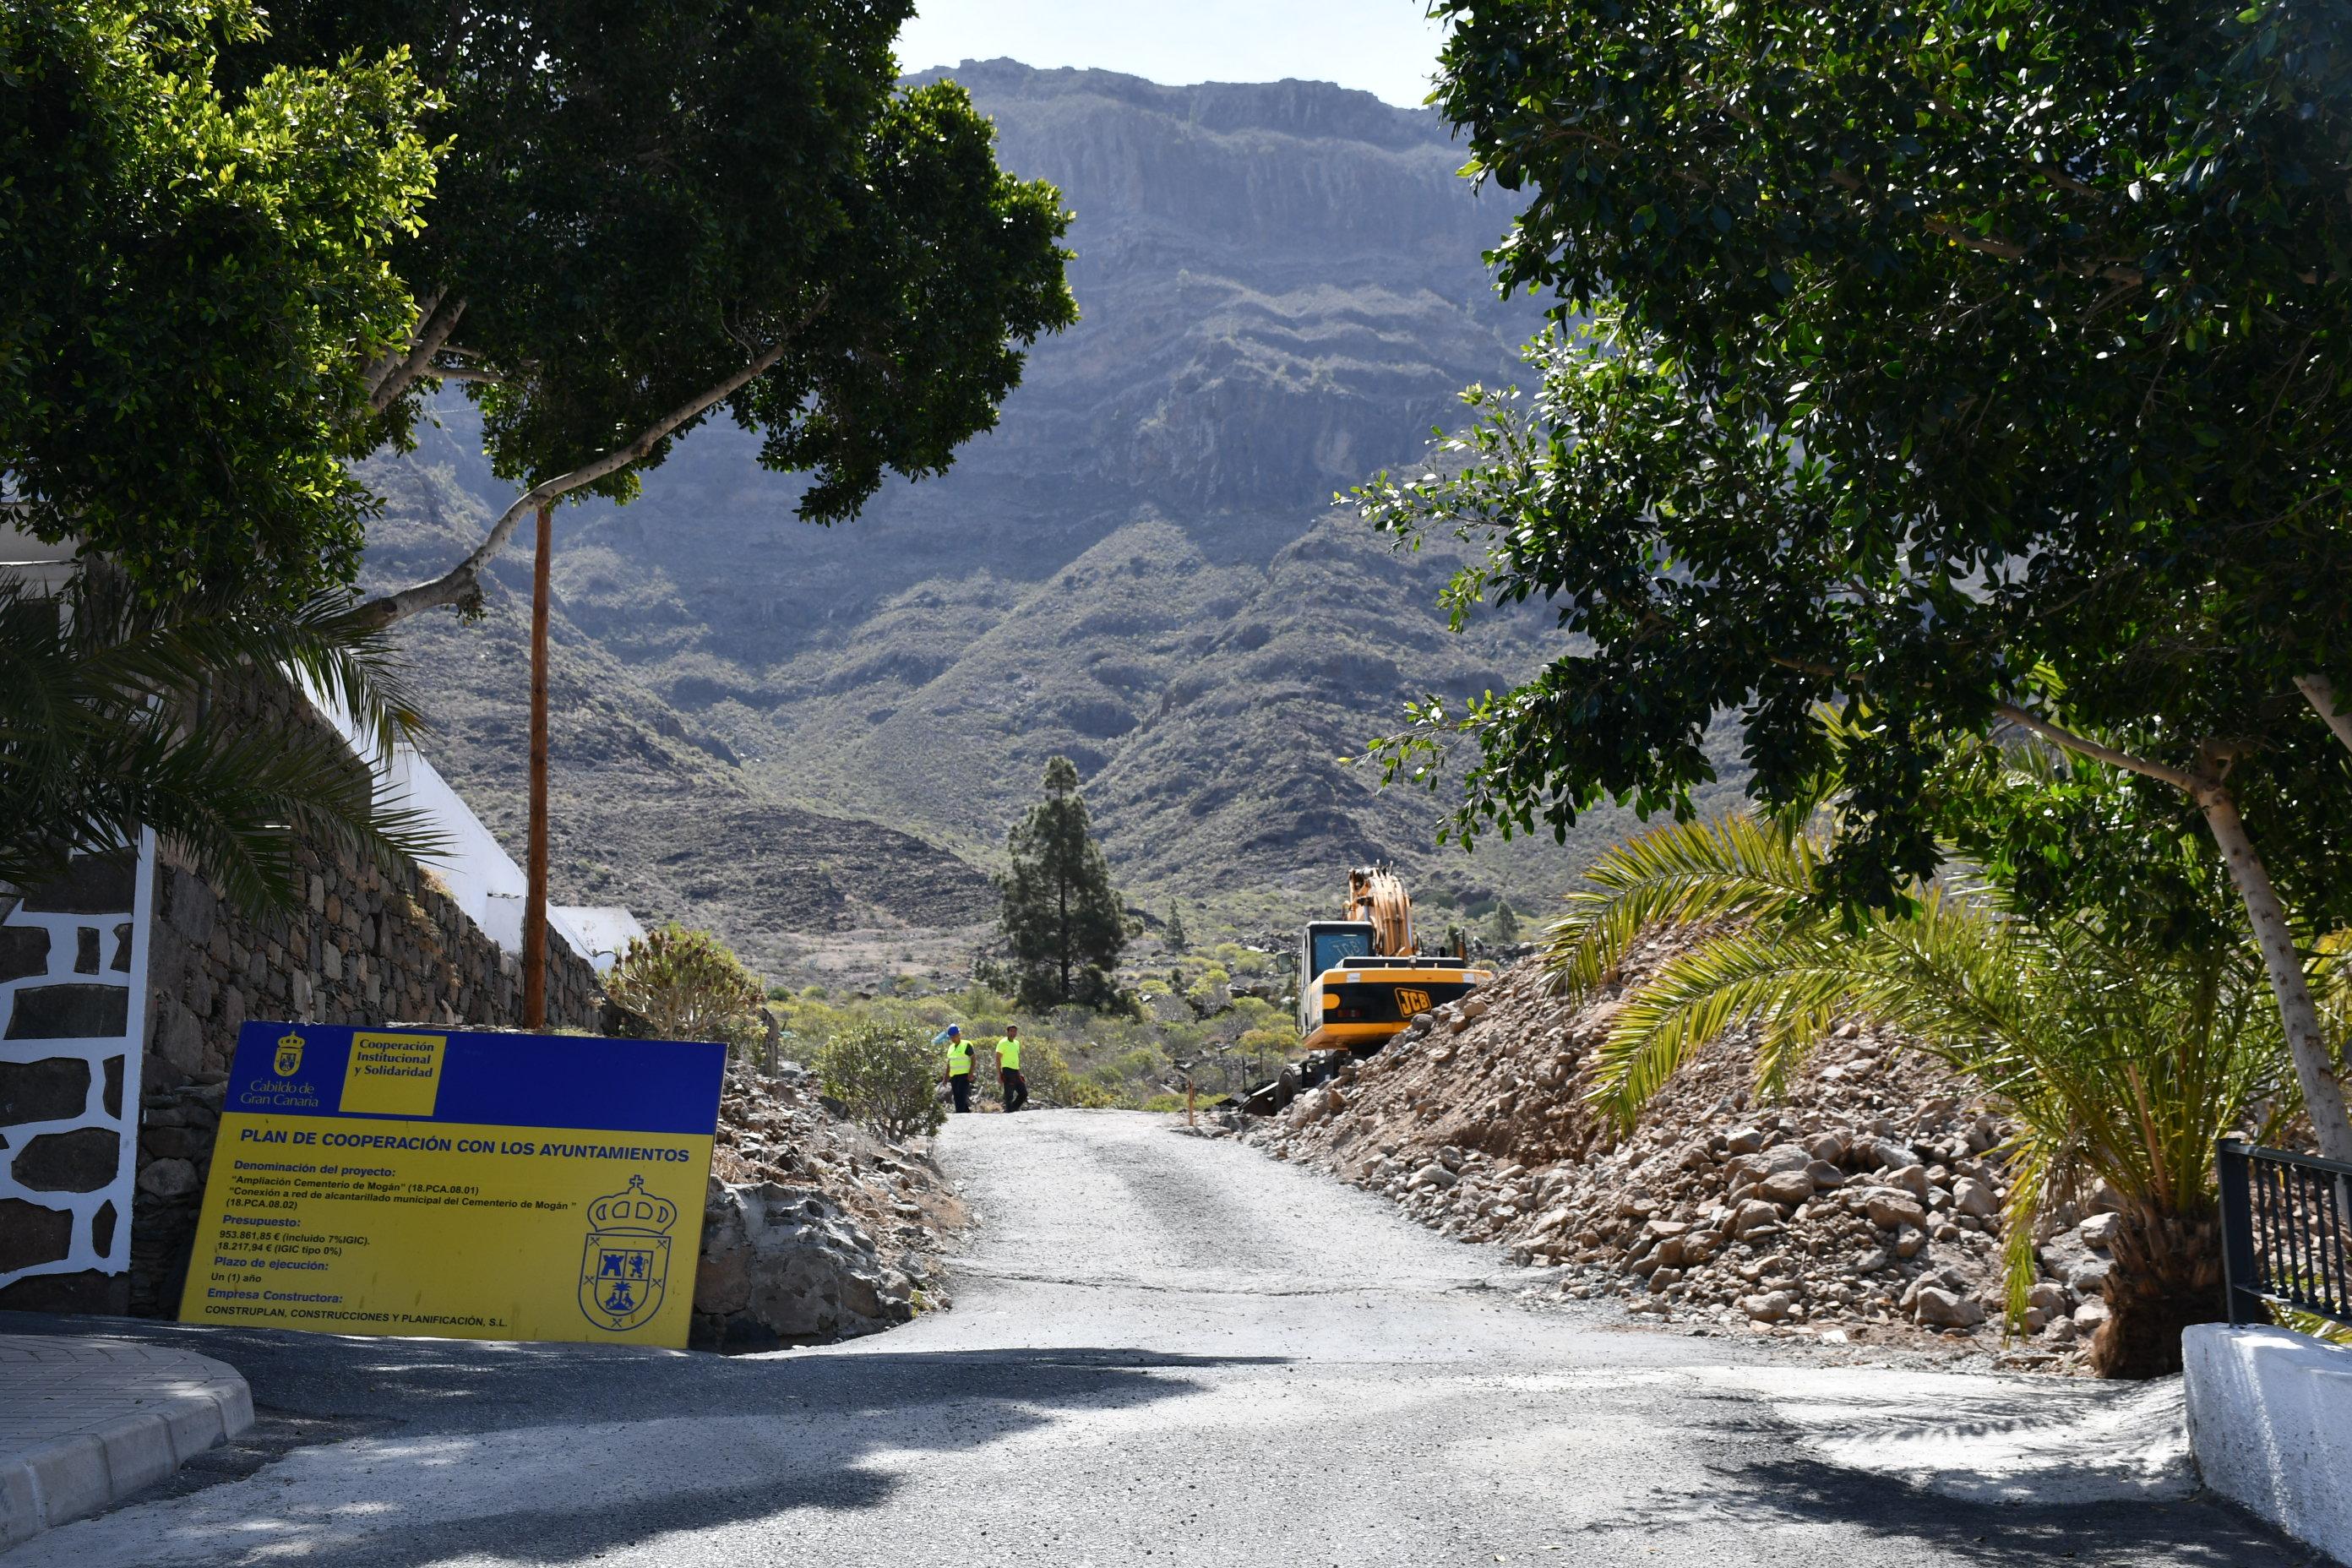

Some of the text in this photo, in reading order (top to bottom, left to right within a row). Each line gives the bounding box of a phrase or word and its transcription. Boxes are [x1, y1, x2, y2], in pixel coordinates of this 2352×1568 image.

[1401, 990, 1428, 1013] JCB
[360, 1039, 434, 1052] Cooperación
[357, 1052, 431, 1064] Institucional
[354, 1065, 433, 1077] y Solidaridad
[251, 1078, 314, 1093] Cabildo de
[241, 1092, 318, 1107] Gran Canaria
[241, 1129, 689, 1162] PLAN DE COOPERACIÓN CON LOS AYUNTAMIENTOS
[235, 1161, 395, 1178] Denominación del proyecto:
[294, 1179, 349, 1190] Cementerio
[408, 1184, 479, 1195] (18.PCA.08.01)
[226, 1199, 297, 1211] (18.PCA.08.02)
[310, 1191, 323, 1200] de
[324, 1192, 390, 1202] alcantarillado
[394, 1195, 441, 1205] municipal
[444, 1197, 459, 1206] del
[461, 1198, 517, 1208] Cementerio
[536, 1200, 568, 1210] Mogán
[222, 1215, 301, 1227] Presupuesto:
[220, 1230, 271, 1240] 953.861,85
[282, 1233, 324, 1243] (incluido
[217, 1242, 263, 1252] 18.217,94
[275, 1244, 299, 1254] (IGIC
[302, 1246, 320, 1255] tipo
[324, 1247, 342, 1256] 0%)
[215, 1257, 329, 1271] Plazo de ejecución:
[227, 1274, 240, 1282] (1)
[208, 1288, 343, 1303] Empresa Constructora:
[205, 1306, 286, 1317] CONSTRUPLAN,
[291, 1309, 389, 1321] CONSTRUCCIONES
[402, 1315, 486, 1327] PLANIFICACIÓN,
